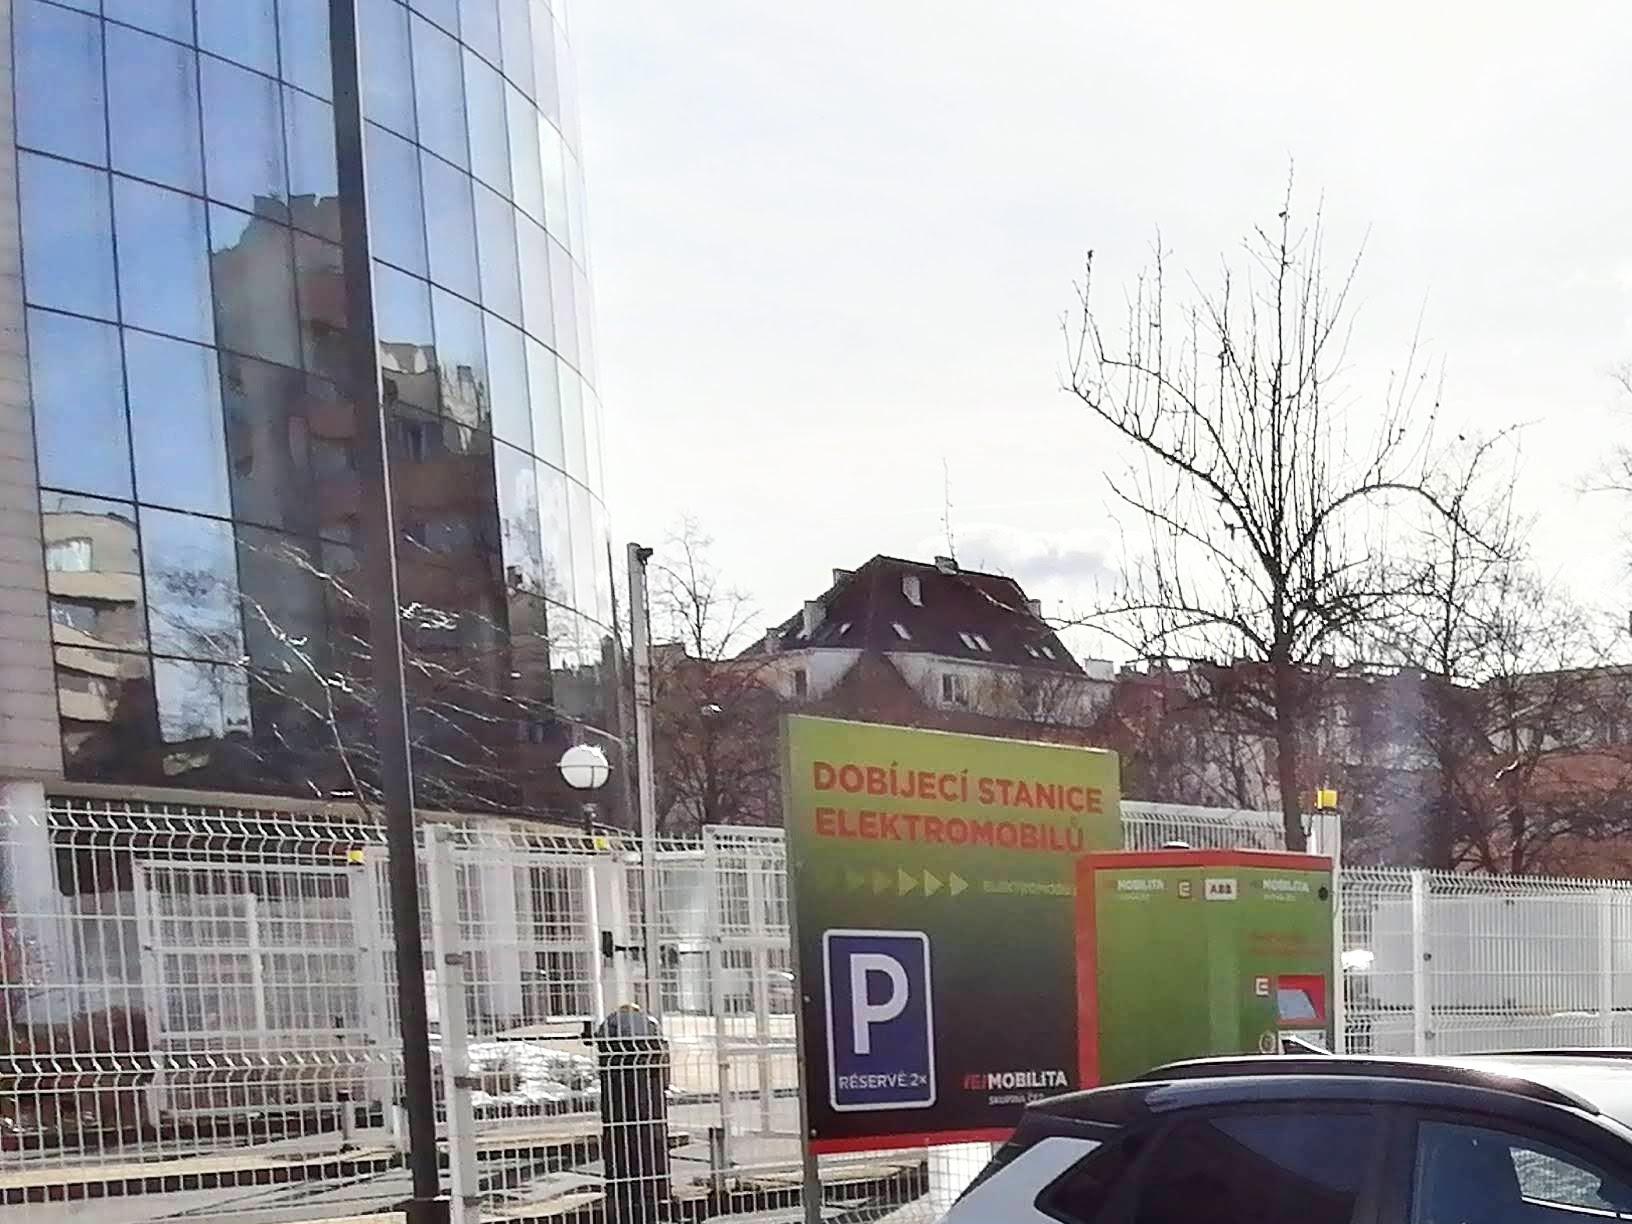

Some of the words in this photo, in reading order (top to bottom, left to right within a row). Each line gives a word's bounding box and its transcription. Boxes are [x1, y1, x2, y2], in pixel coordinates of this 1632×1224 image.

[812, 760, 969, 803] DOBÍJECÍ
[977, 776, 1104, 815] STANICE
[815, 806, 1084, 852] ELEKTROMOBILŮ
[850, 953, 909, 1054] P
